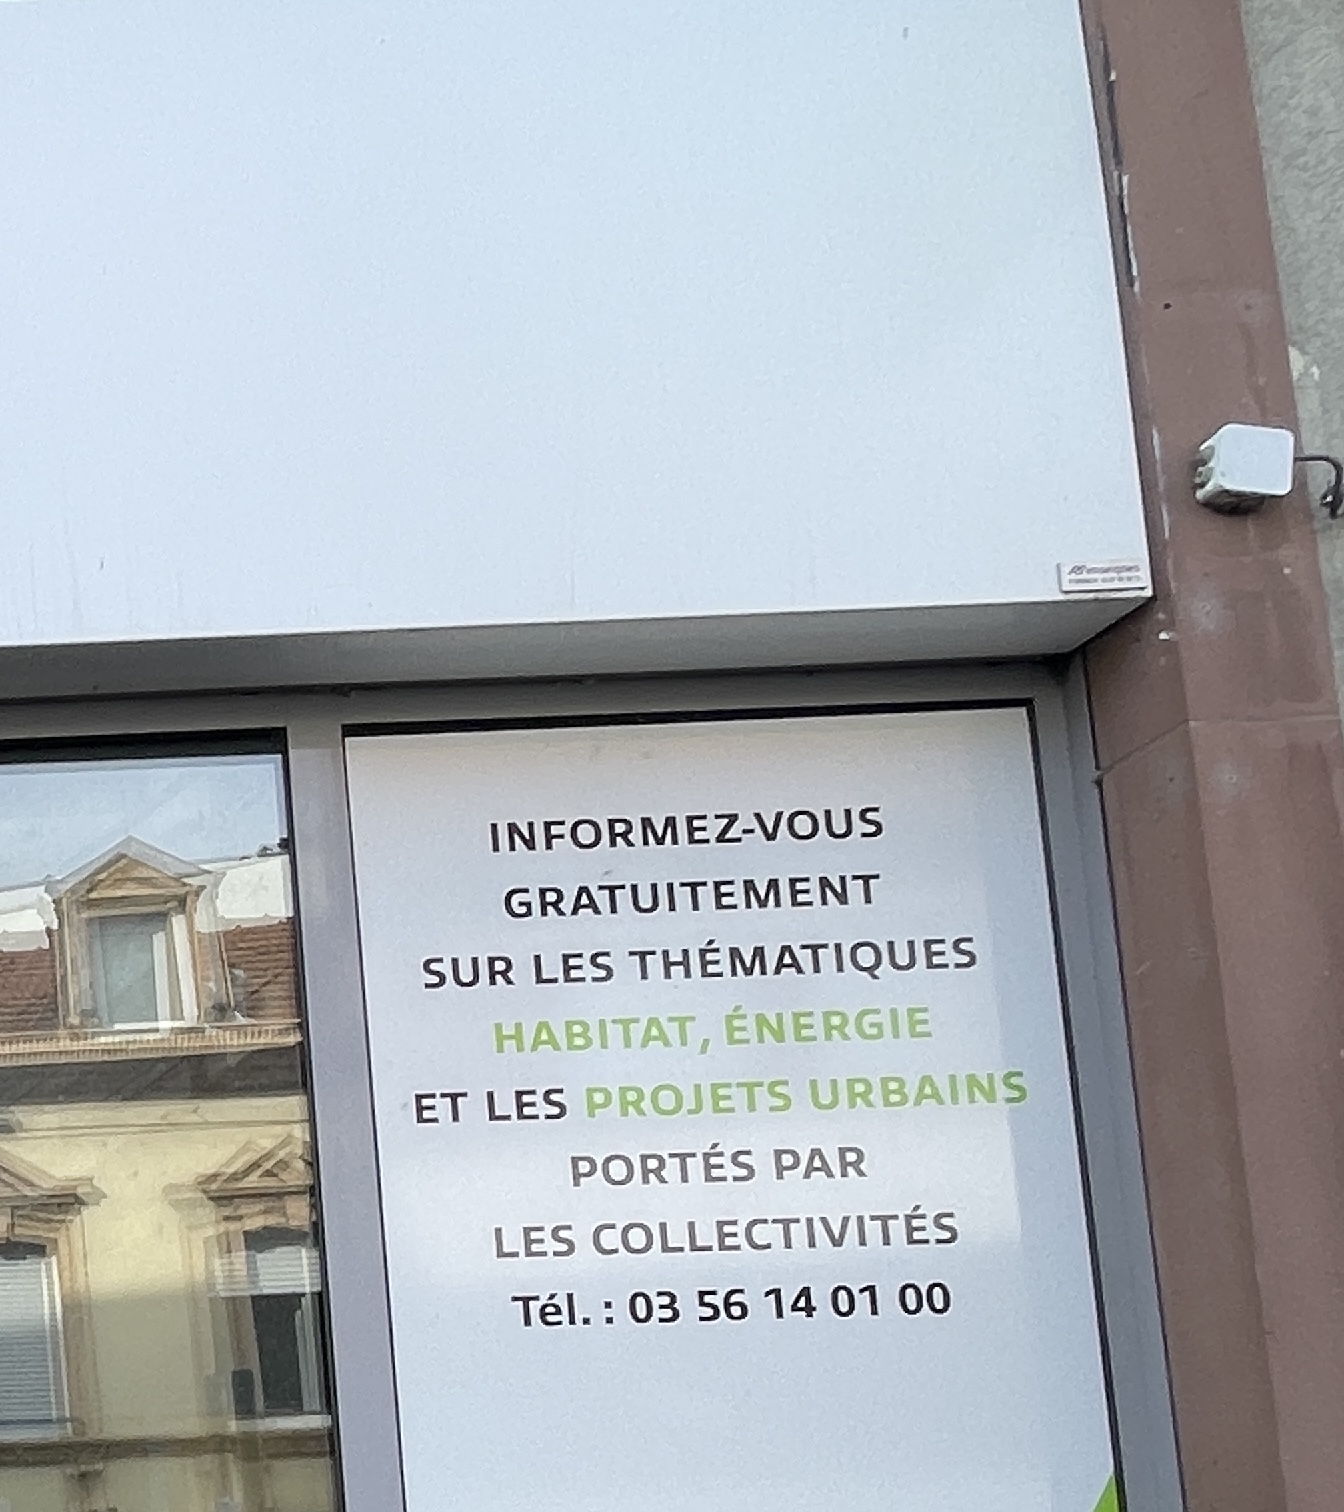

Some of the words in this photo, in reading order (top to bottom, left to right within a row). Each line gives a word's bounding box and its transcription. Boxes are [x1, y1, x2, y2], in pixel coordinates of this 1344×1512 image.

[489, 806, 884, 853] INFORMEZ-VOUS
[503, 873, 881, 918] GRATUITEMENT
[422, 955, 514, 989] SUR
[533, 951, 614, 986] LES
[629, 936, 979, 981] THÉMATIQUES
[494, 1014, 712, 1055] HABITAT,
[725, 1004, 933, 1047] ÉNERGIE
[414, 1090, 468, 1124] ET
[487, 1086, 568, 1122] LES
[585, 1078, 792, 1118] PROJETS
[808, 1070, 1028, 1111] URBAINS
[571, 1142, 755, 1187] PORTÉS
[773, 1146, 866, 1180] PAR
[494, 1223, 575, 1260] LES
[591, 1204, 958, 1256] COLLECTIVITÉS
[512, 1292, 591, 1327] Tél.
[628, 1289, 680, 1324] 03
[696, 1287, 748, 1322] 56
[765, 1286, 816, 1320] 14
[831, 1283, 880, 1317] 01
[898, 1281, 951, 1316] 00
